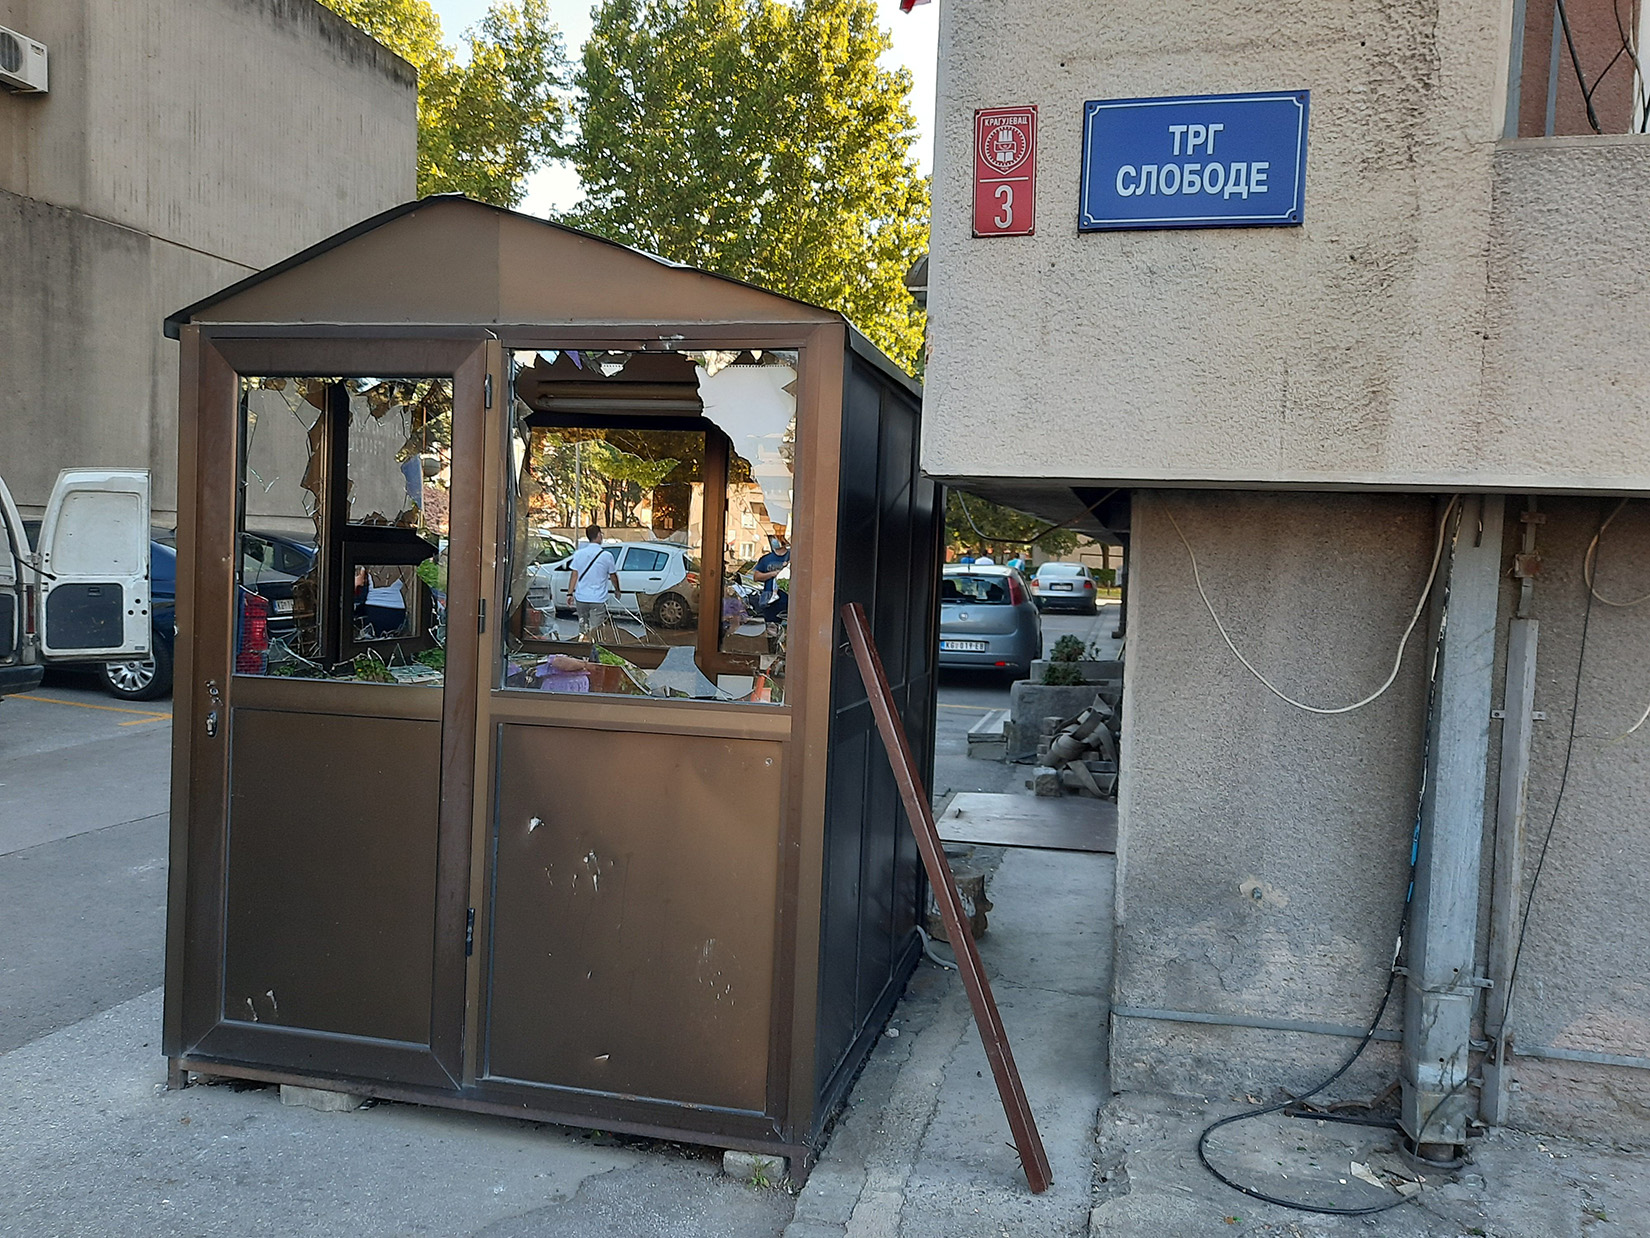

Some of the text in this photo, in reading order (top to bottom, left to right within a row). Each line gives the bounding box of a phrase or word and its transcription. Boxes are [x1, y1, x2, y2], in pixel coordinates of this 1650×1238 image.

[1168, 123, 1224, 156] ТРГ
[1116, 161, 1270, 200] СЛОБОДЕ
[994, 184, 1014, 229] 3
